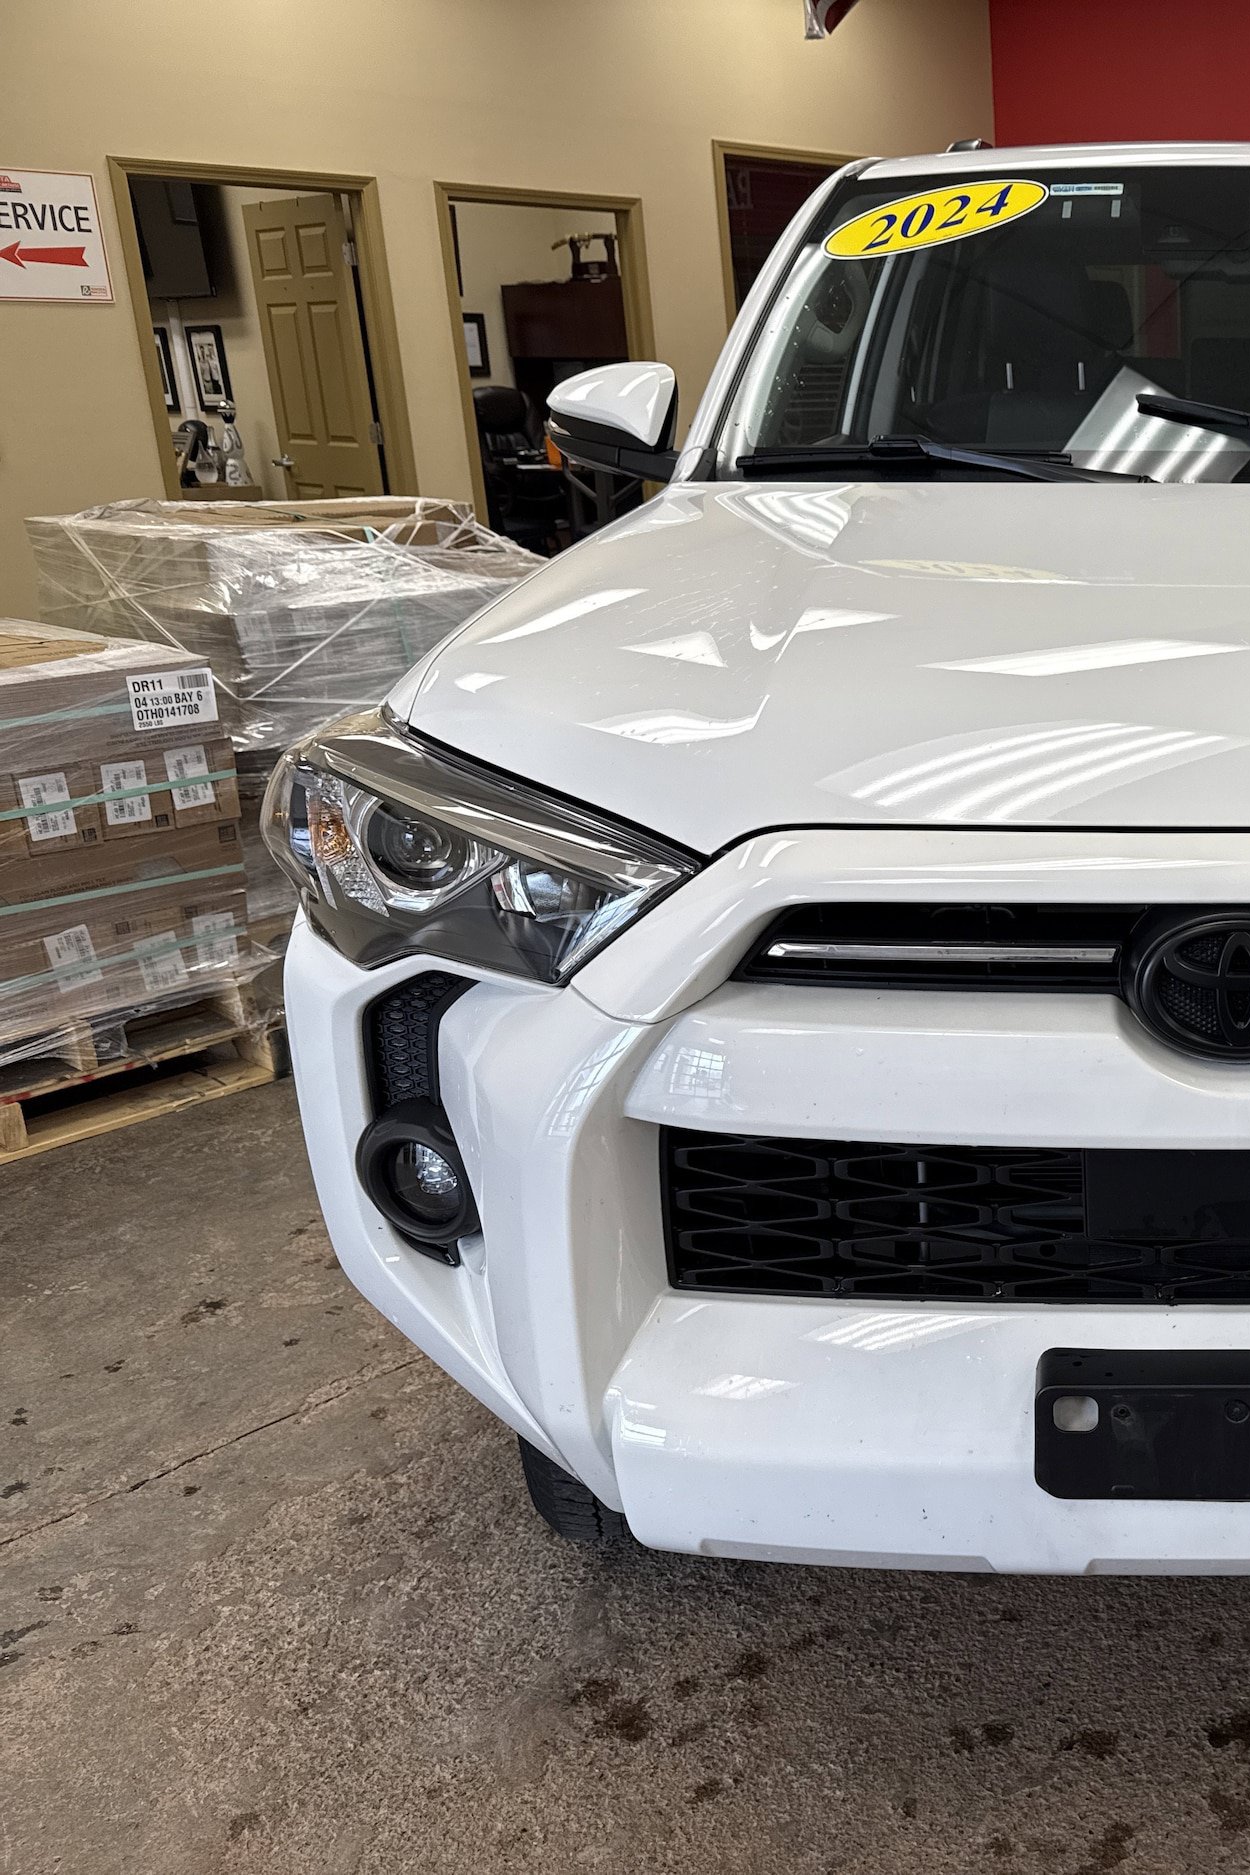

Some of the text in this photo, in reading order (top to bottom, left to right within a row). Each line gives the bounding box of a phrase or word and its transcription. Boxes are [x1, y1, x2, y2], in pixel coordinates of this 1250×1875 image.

[861, 183, 1014, 253] 2024
[132, 679, 163, 693] DR11
[134, 690, 203, 708] 04 13:00 BAY 6
